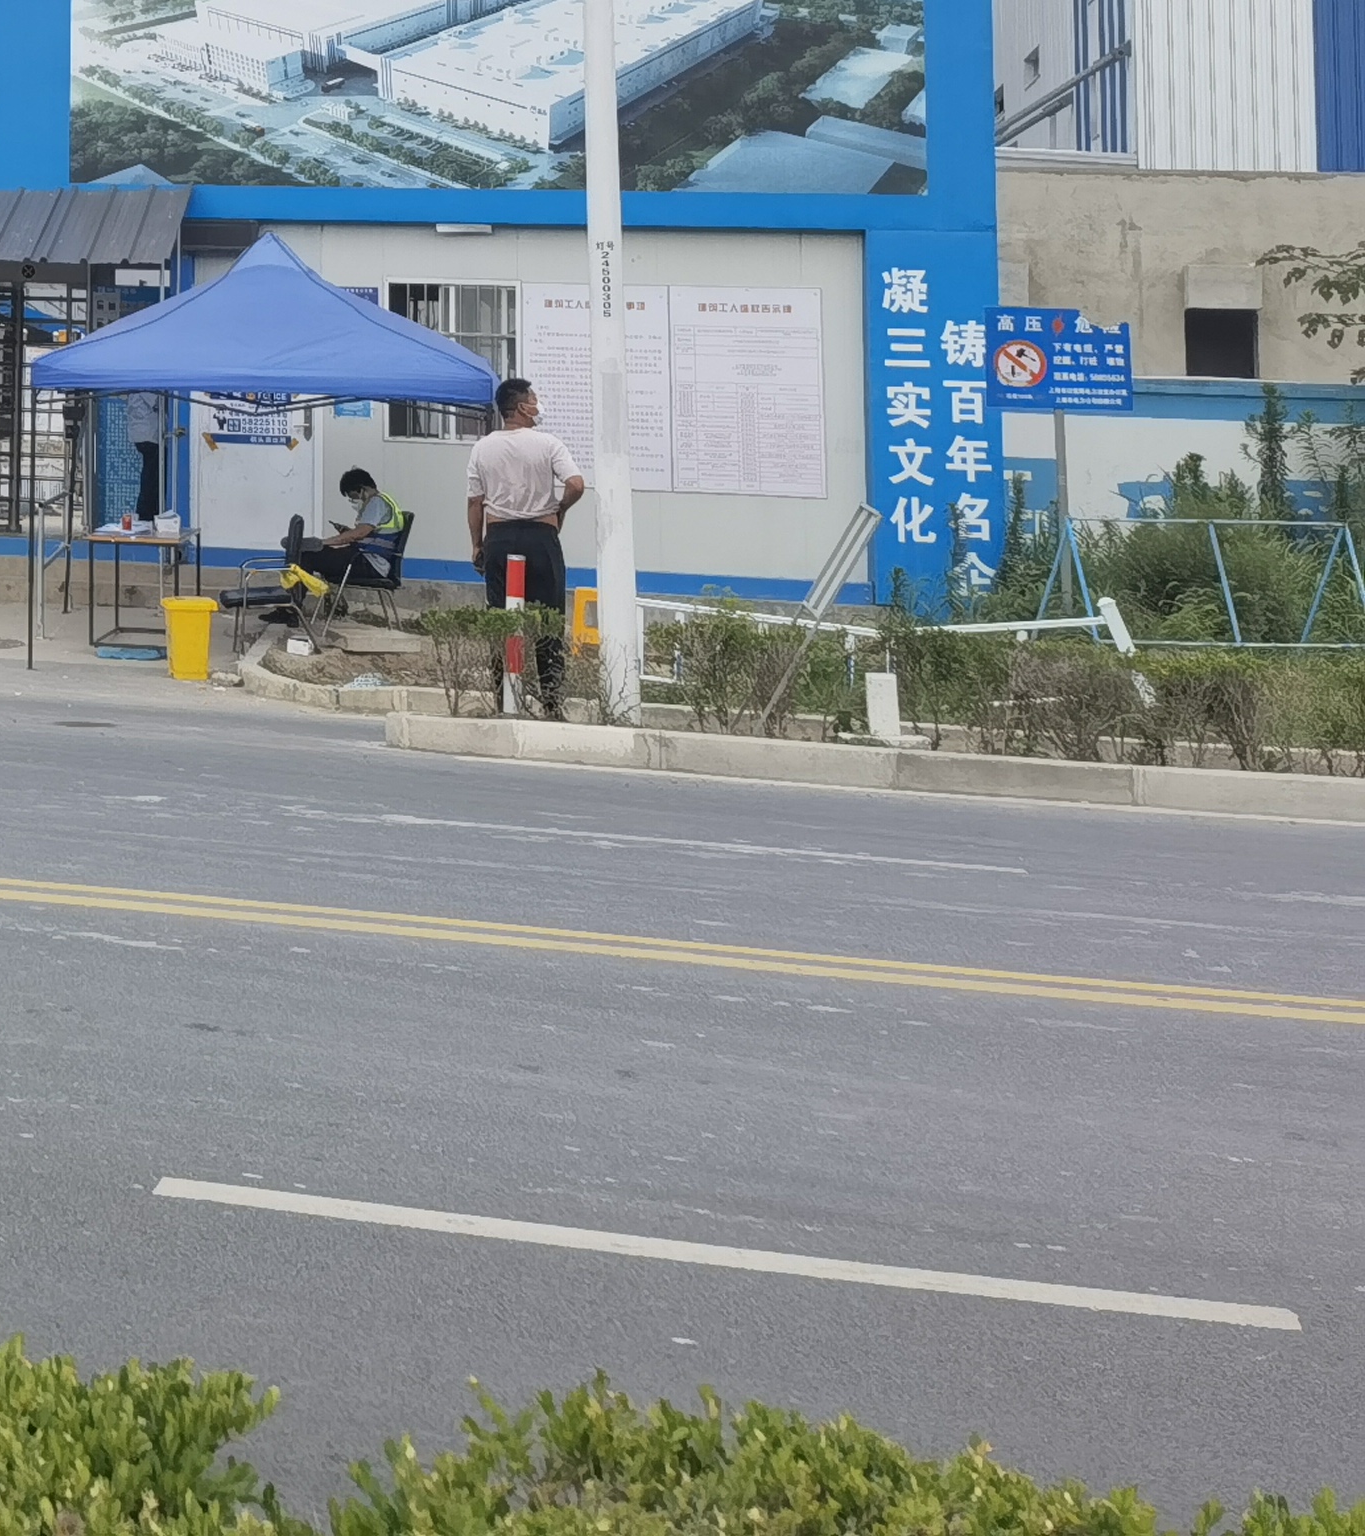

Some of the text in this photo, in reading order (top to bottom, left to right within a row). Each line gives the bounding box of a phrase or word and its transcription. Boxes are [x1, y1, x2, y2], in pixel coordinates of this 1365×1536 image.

[997, 314, 1044, 332] 高压
[881, 266, 938, 545] 凝三实文化
